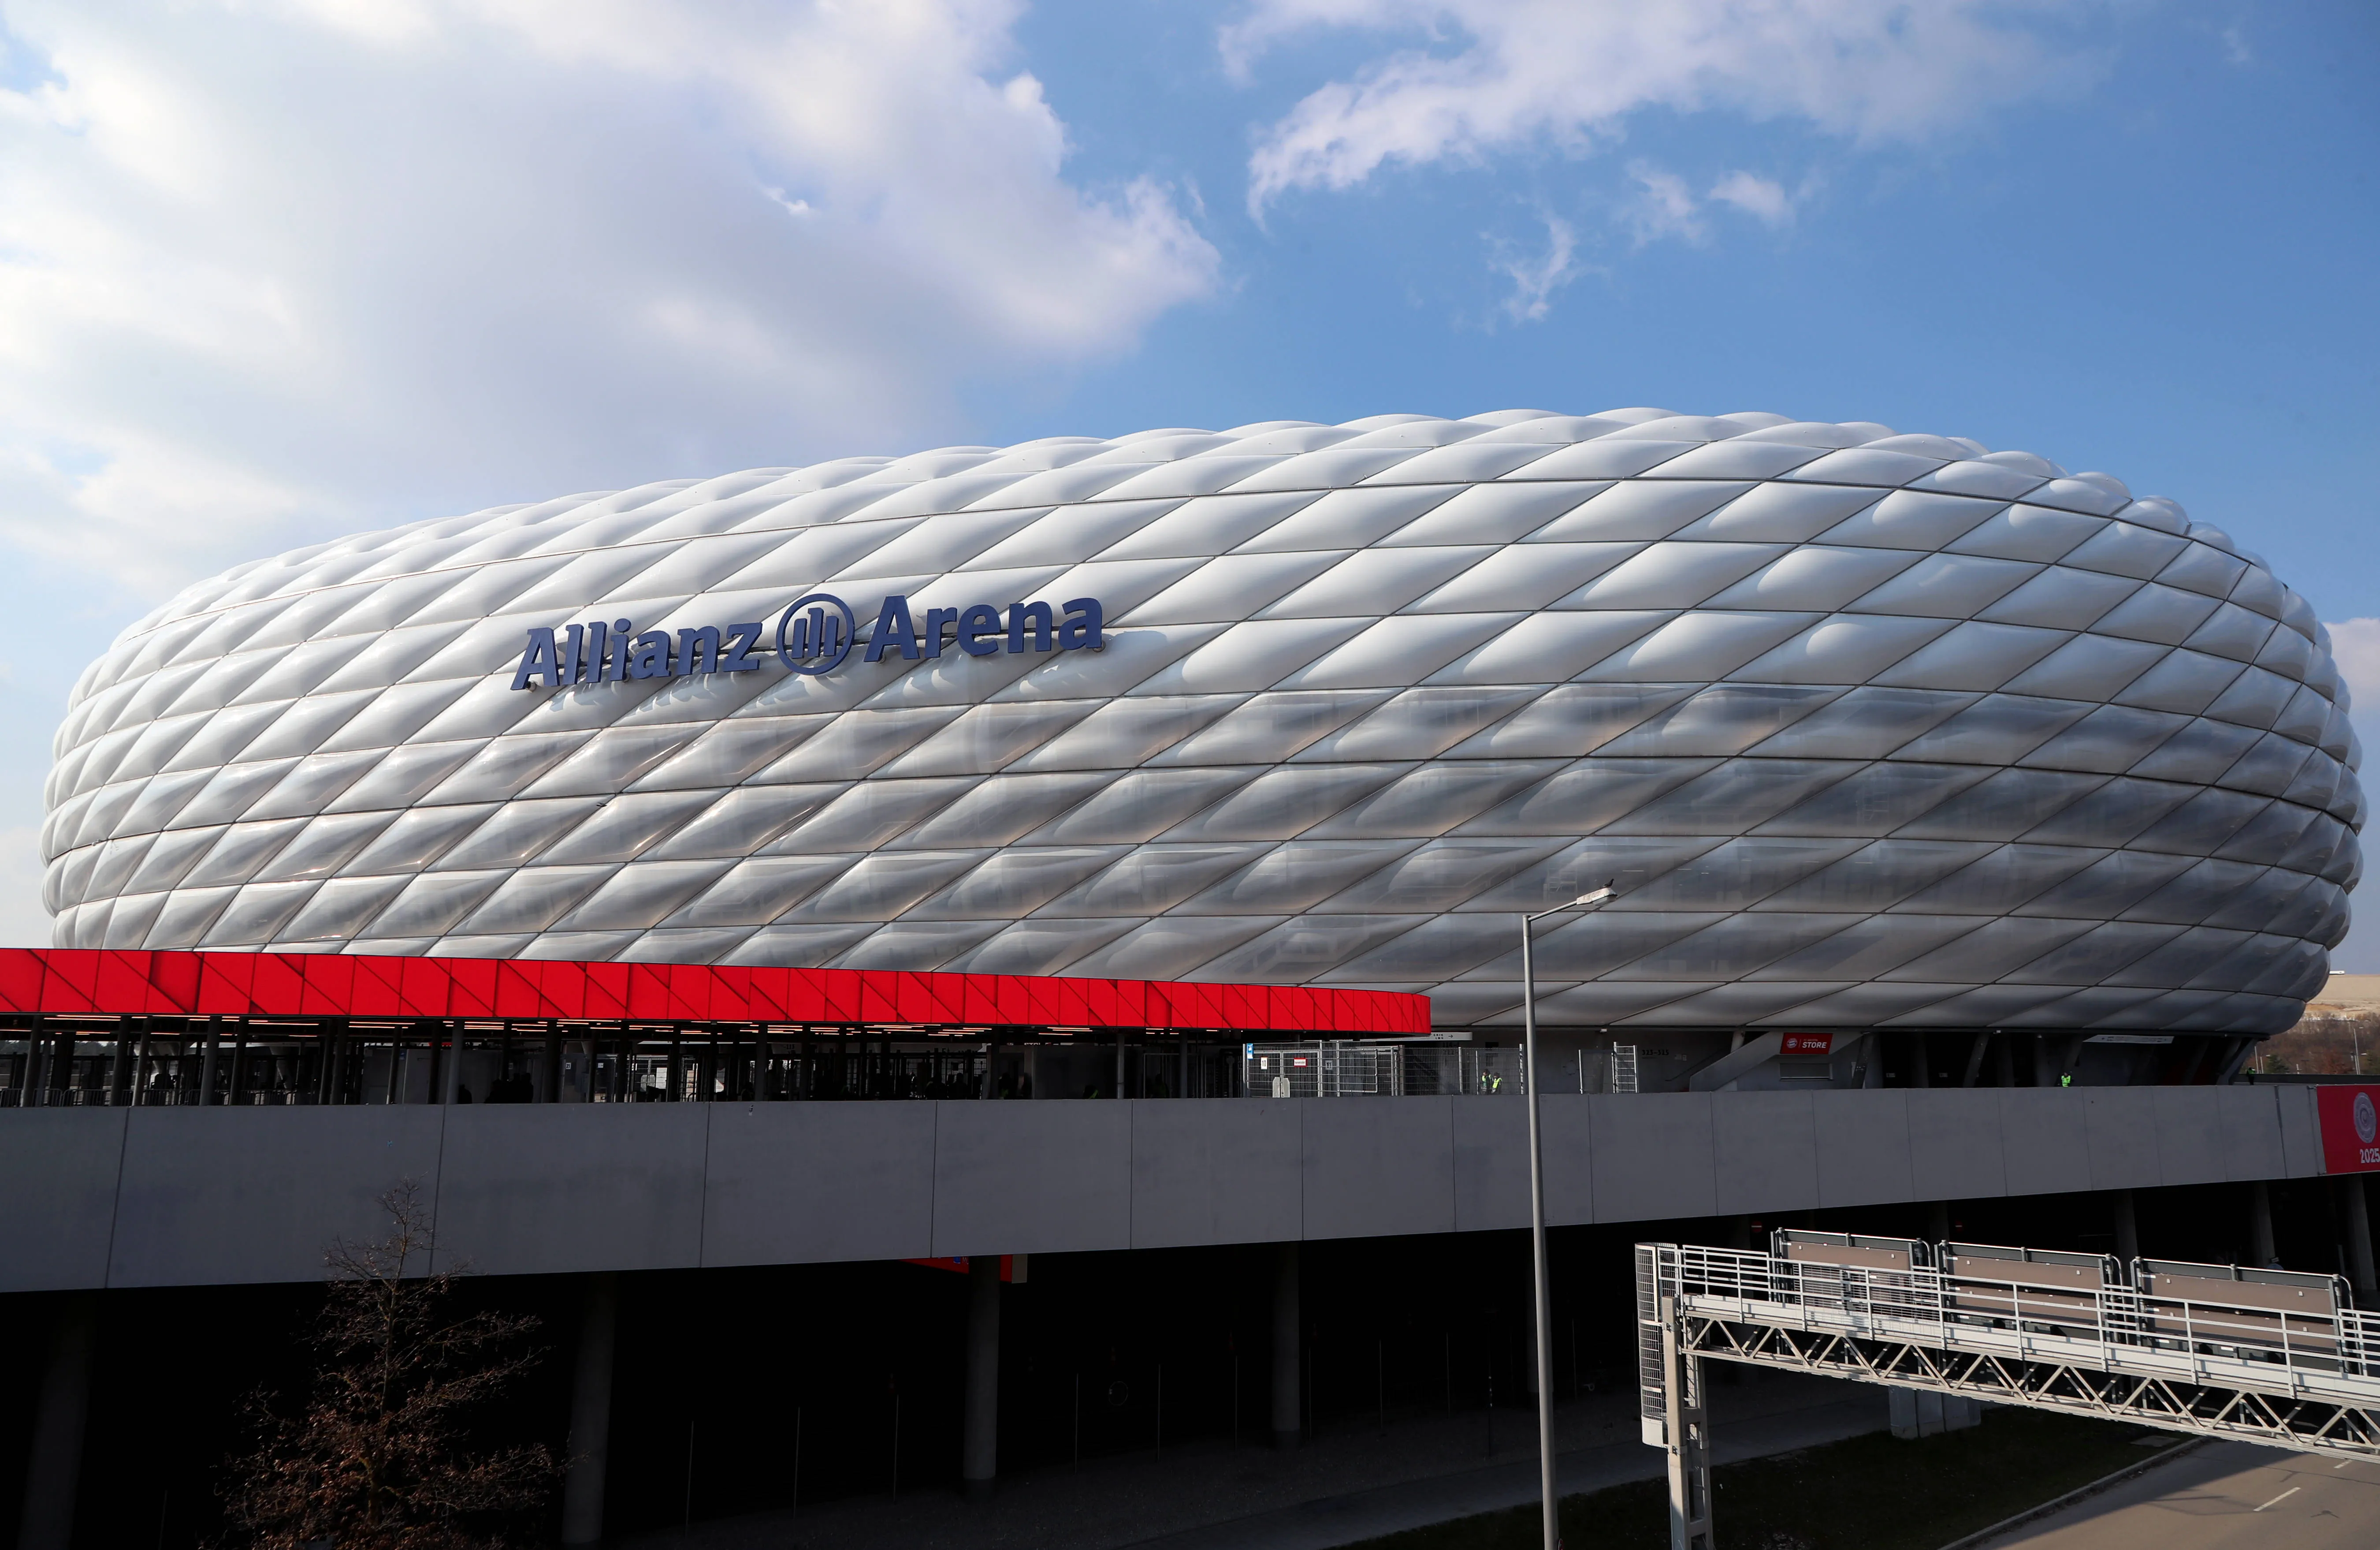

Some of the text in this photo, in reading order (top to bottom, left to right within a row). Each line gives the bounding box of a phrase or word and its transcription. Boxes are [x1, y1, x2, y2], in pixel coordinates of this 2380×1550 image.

[510, 595, 1103, 690] Allianz Arena
[2359, 1148, 2380, 1164] 2025
